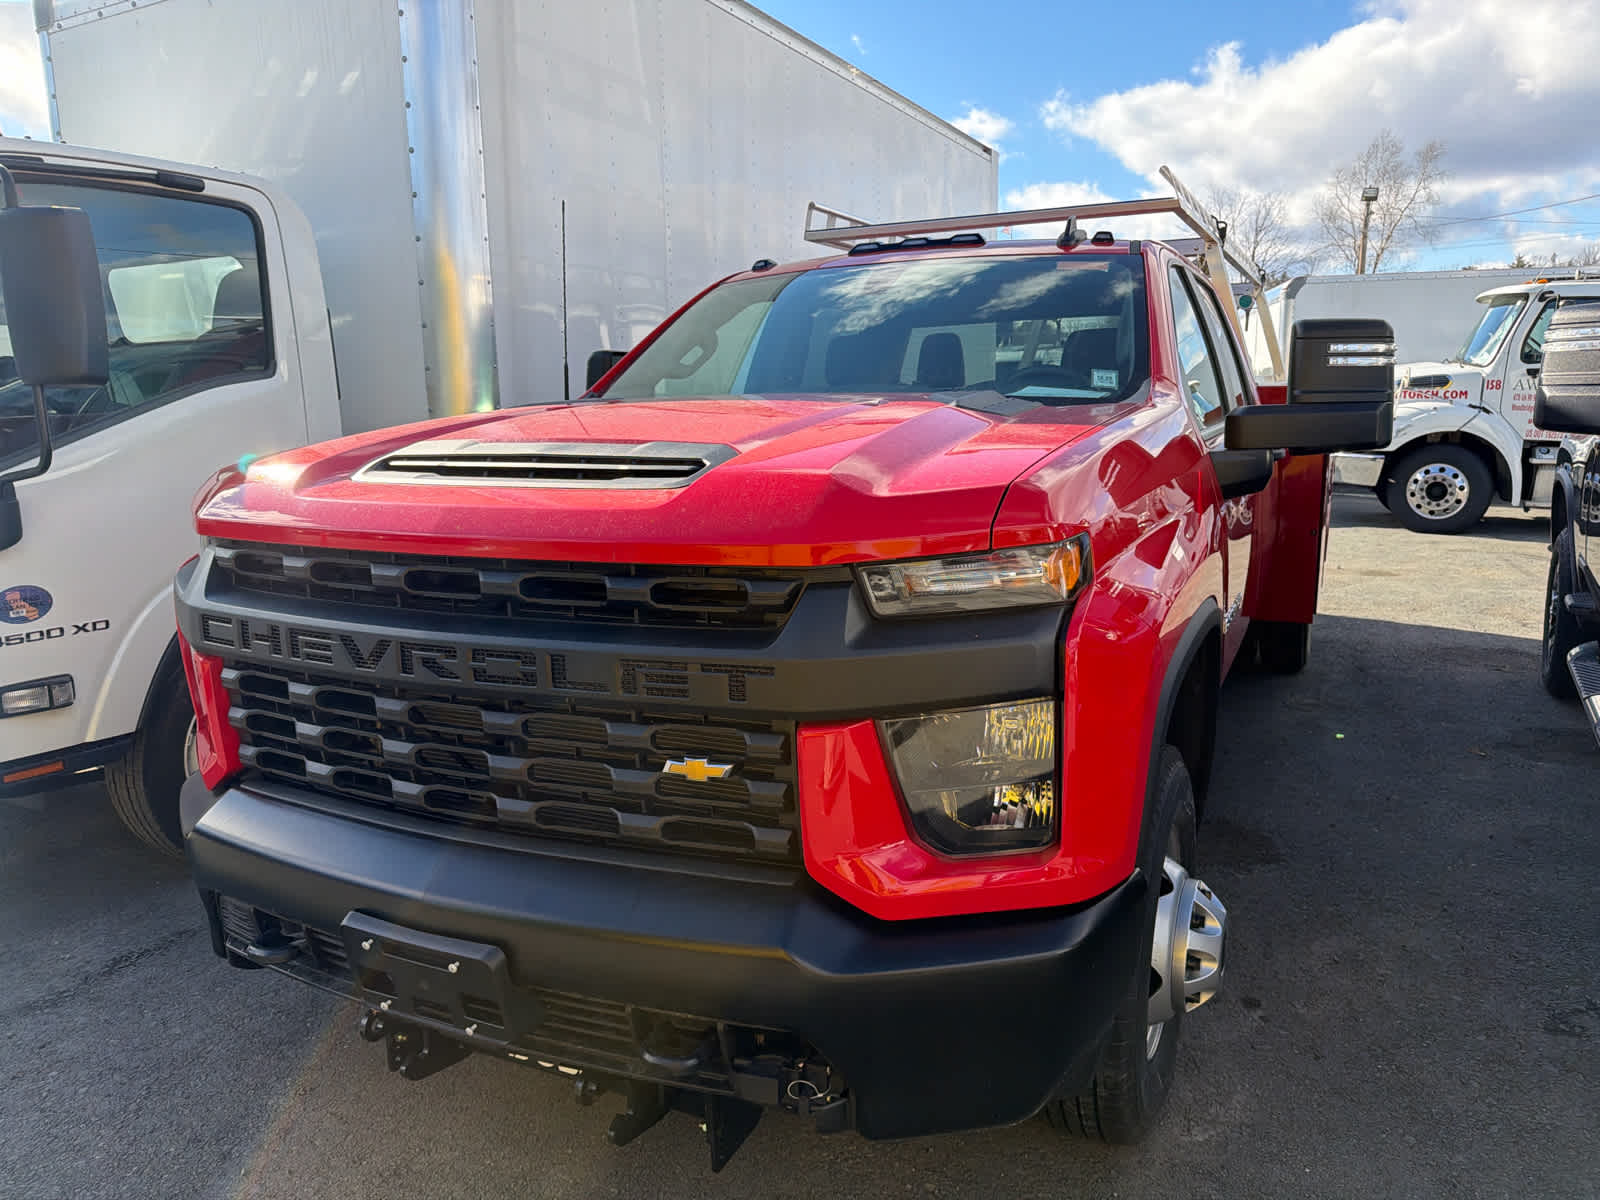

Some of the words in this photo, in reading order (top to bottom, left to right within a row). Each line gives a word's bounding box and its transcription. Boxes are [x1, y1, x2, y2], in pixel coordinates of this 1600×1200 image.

[1486, 379, 1502, 391] 158
[71, 619, 110, 636] XD
[202, 613, 776, 702] CHEVROLET
